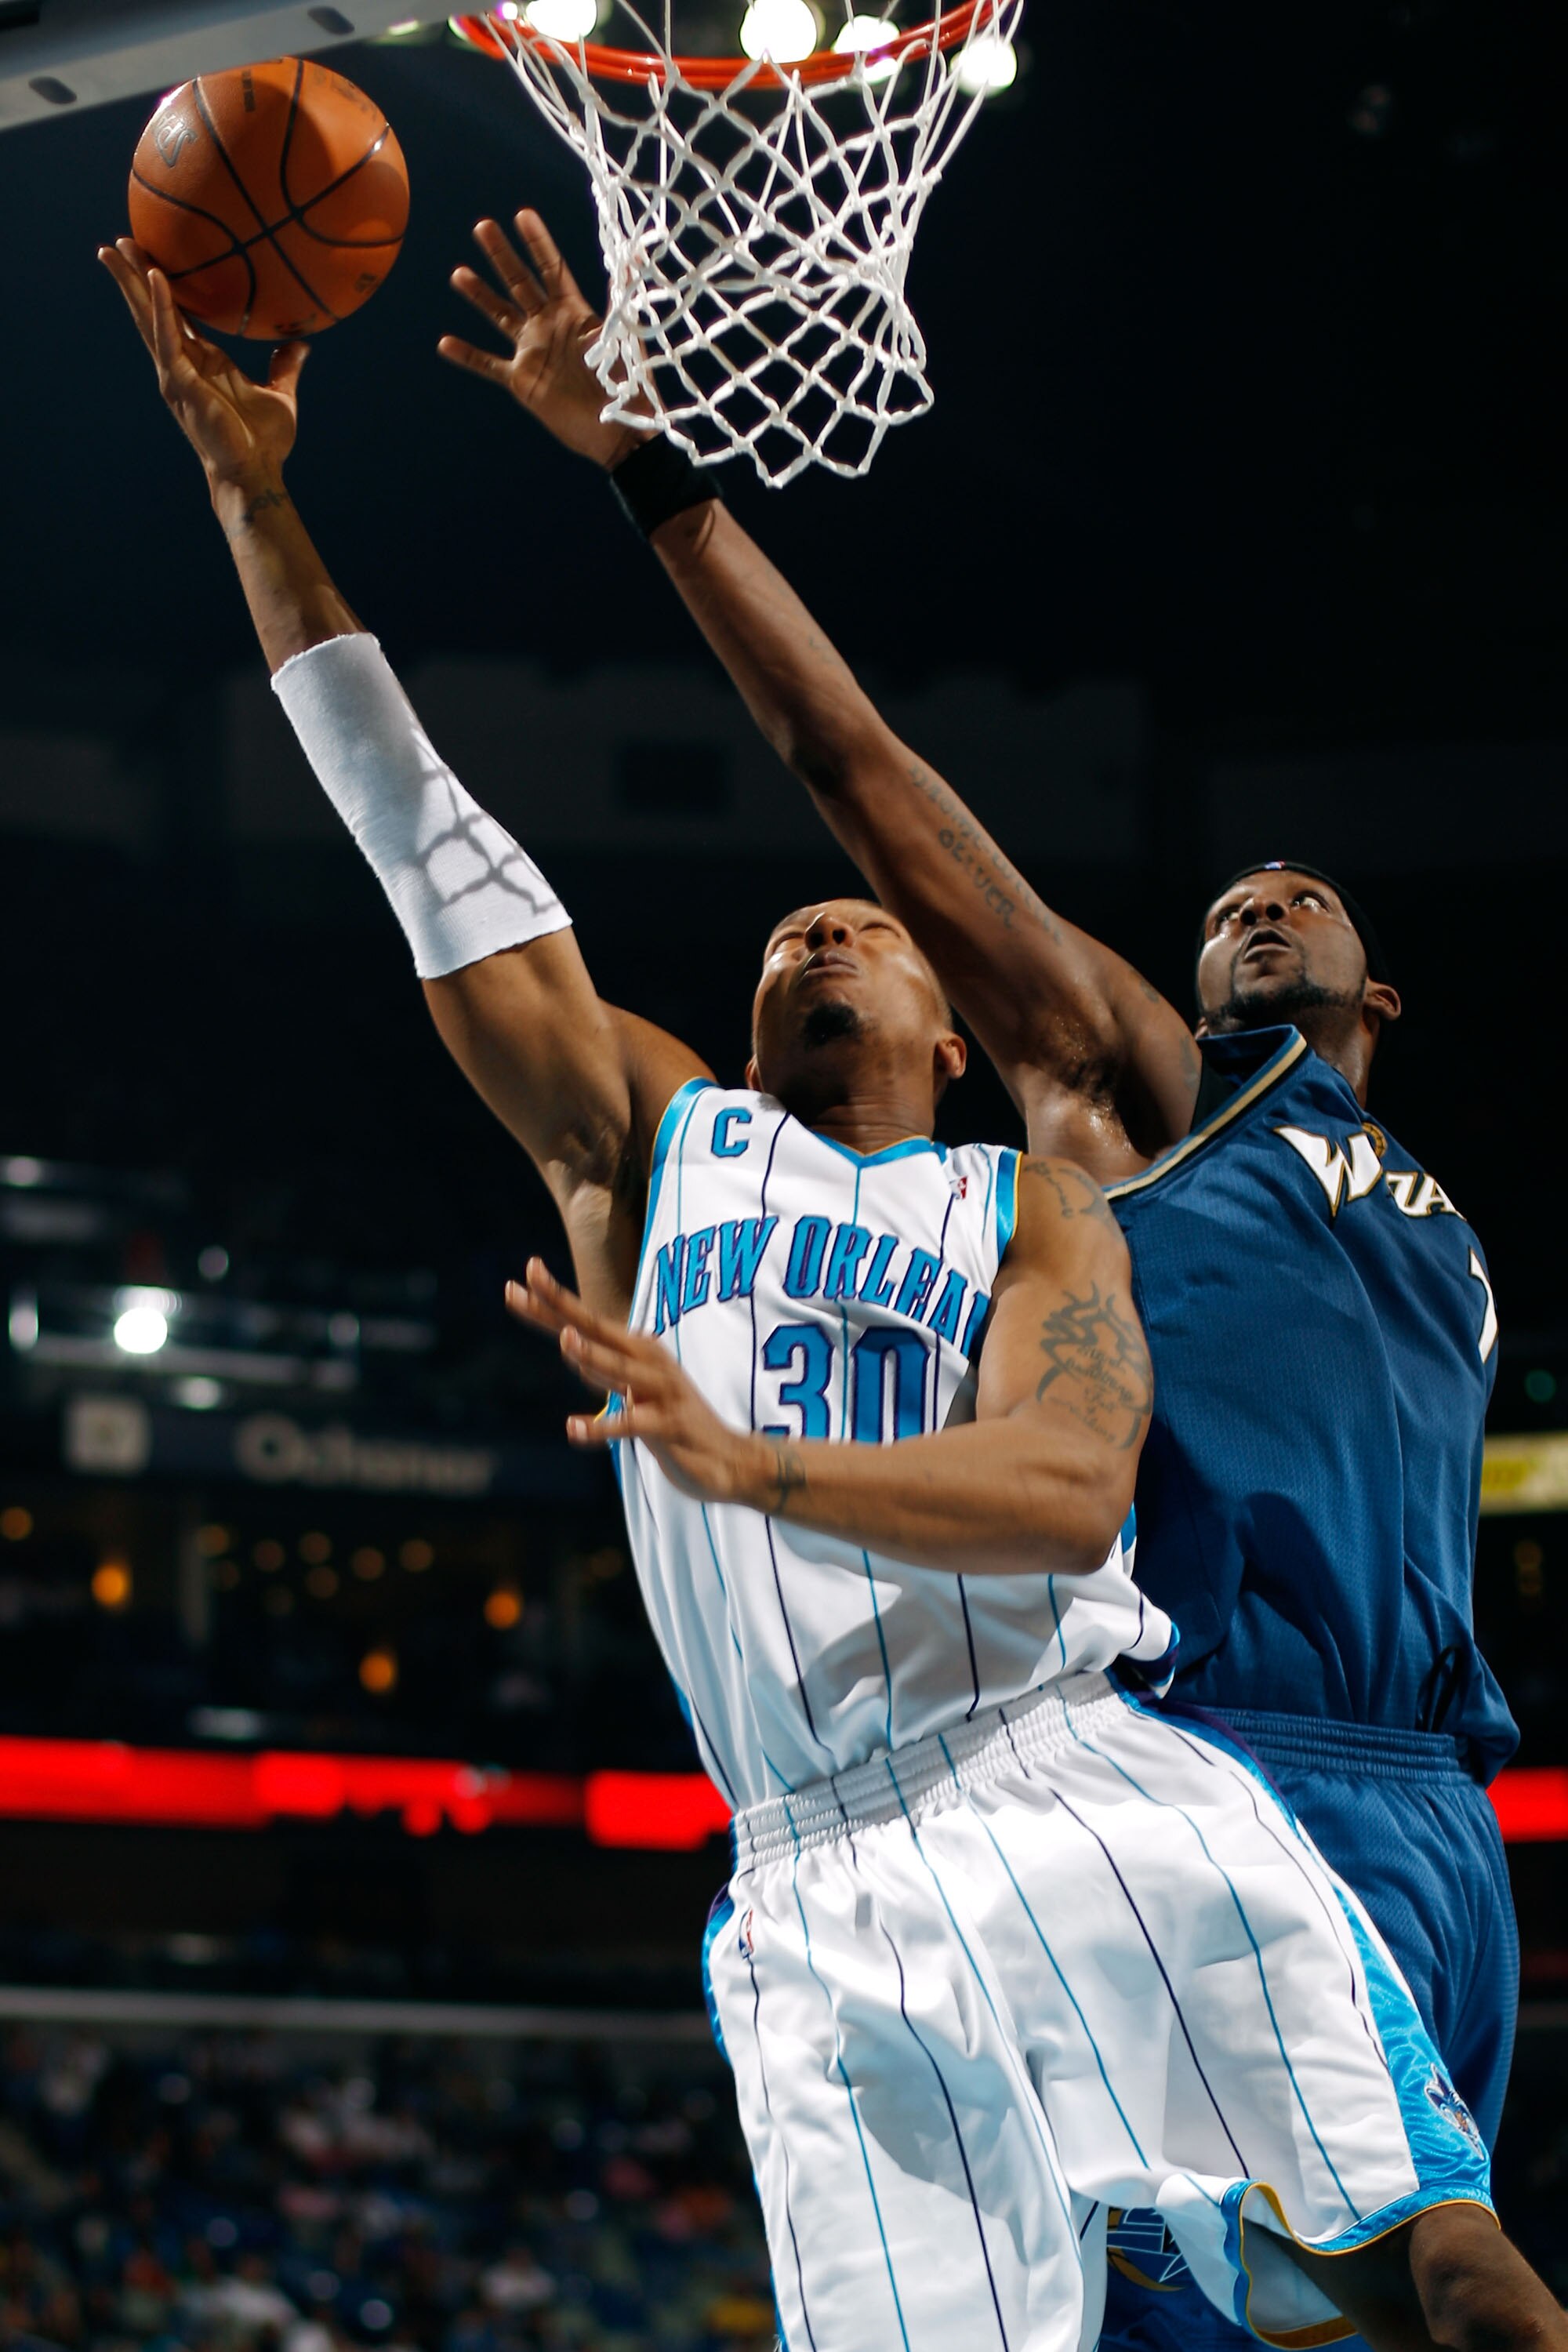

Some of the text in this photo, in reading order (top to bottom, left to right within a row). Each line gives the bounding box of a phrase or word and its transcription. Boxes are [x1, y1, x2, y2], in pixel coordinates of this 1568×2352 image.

[710, 1106, 753, 1158] C
[652, 1215, 779, 1337] NEW
[760, 1322, 931, 1444] 30
